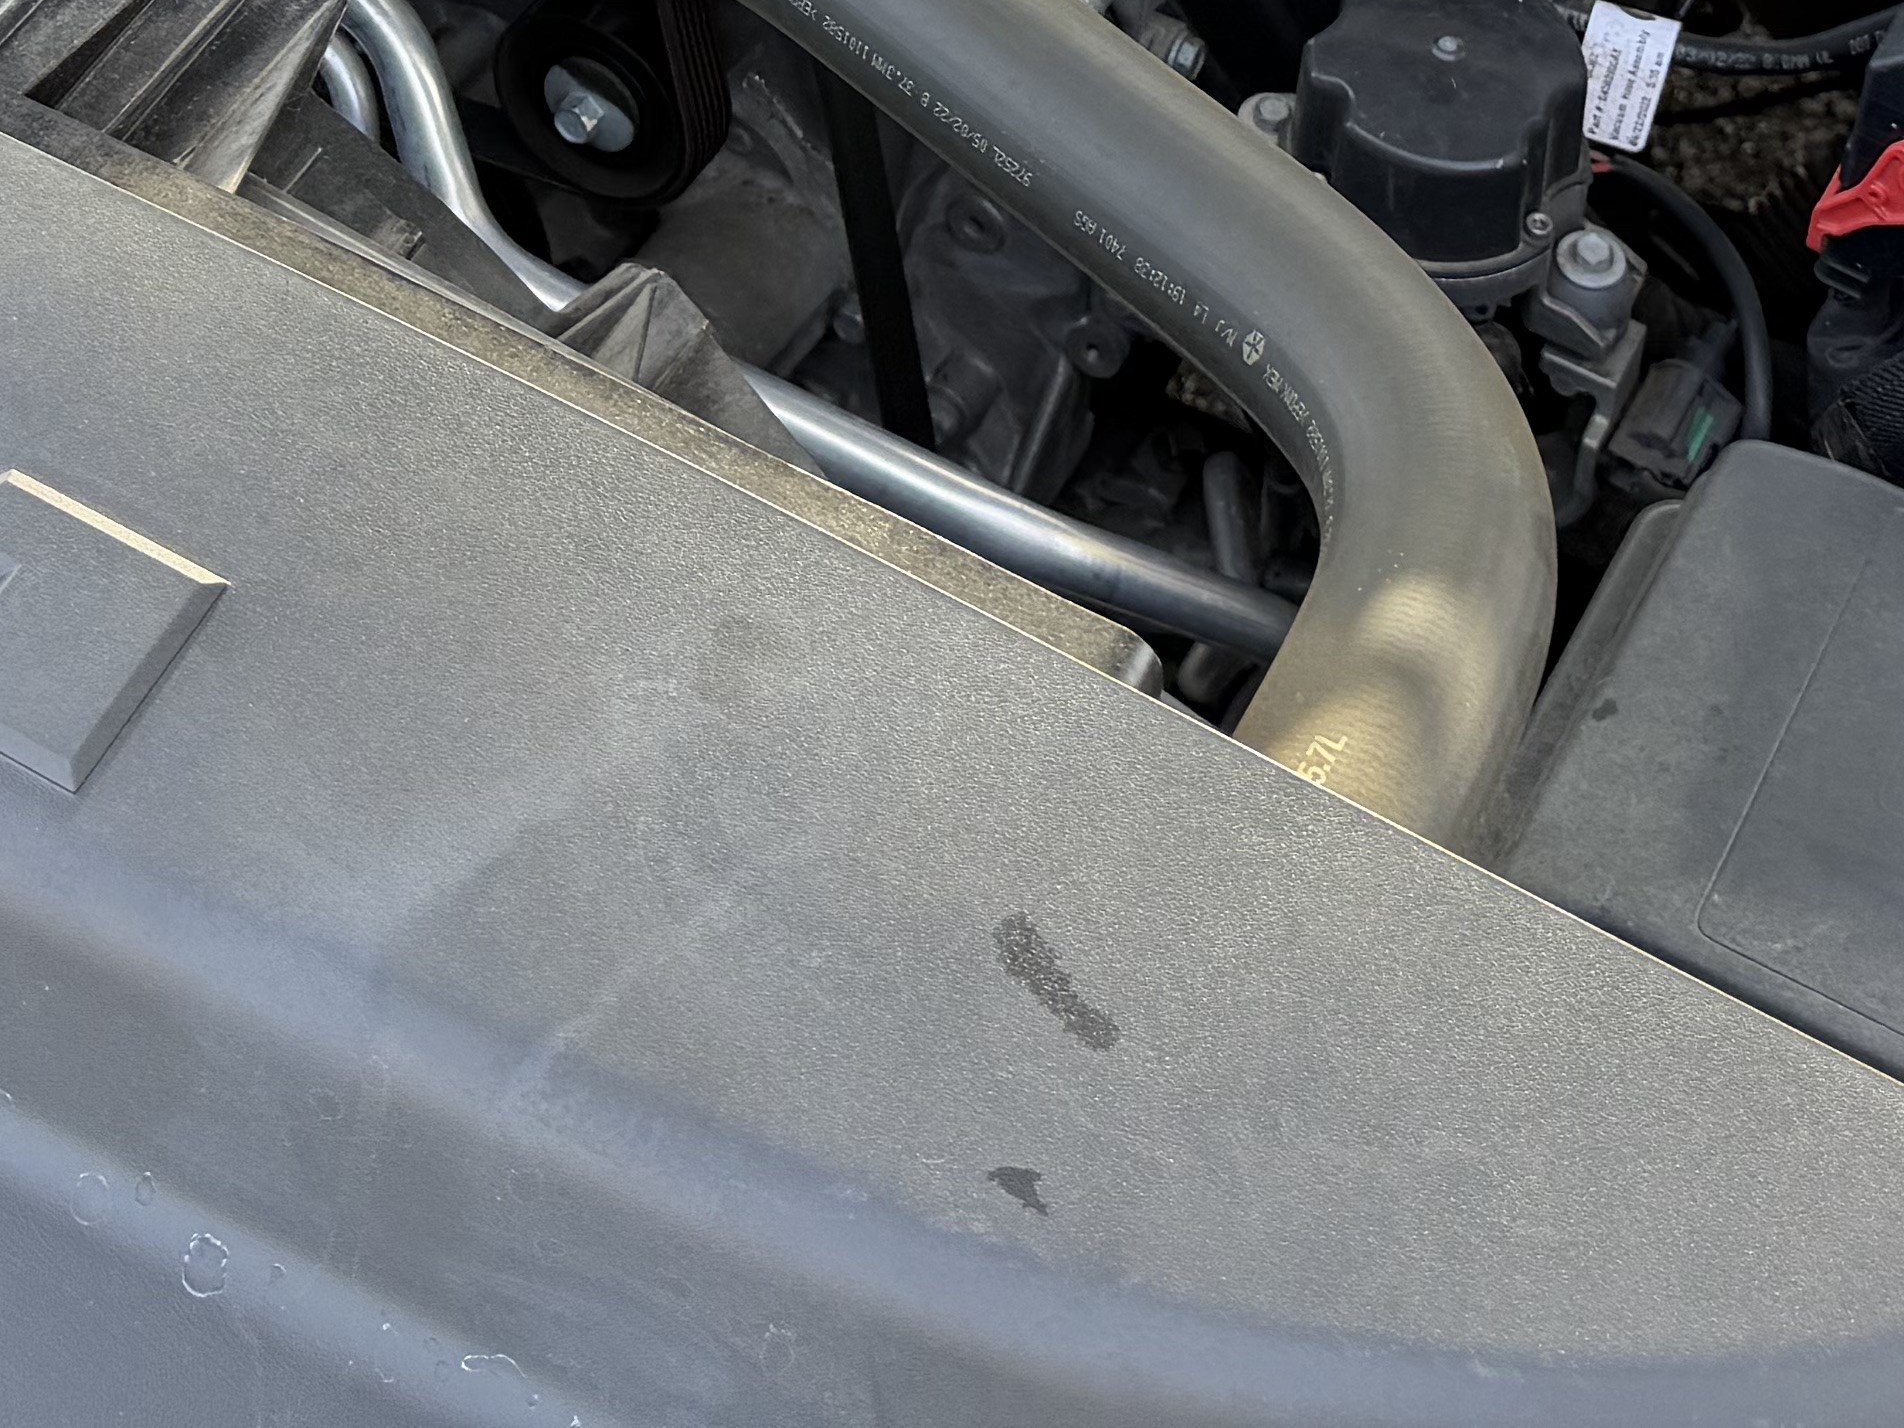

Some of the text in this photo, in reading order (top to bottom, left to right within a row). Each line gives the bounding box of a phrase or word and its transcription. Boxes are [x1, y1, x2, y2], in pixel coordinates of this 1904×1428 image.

[918, 90, 932, 106] B
[1609, 103, 1628, 141] Vacuum
[1628, 29, 1652, 77] Assembly
[930, 100, 991, 153] 05/02/22
[1093, 226, 1130, 261] 7401
[1294, 734, 1350, 786] 5.7L
